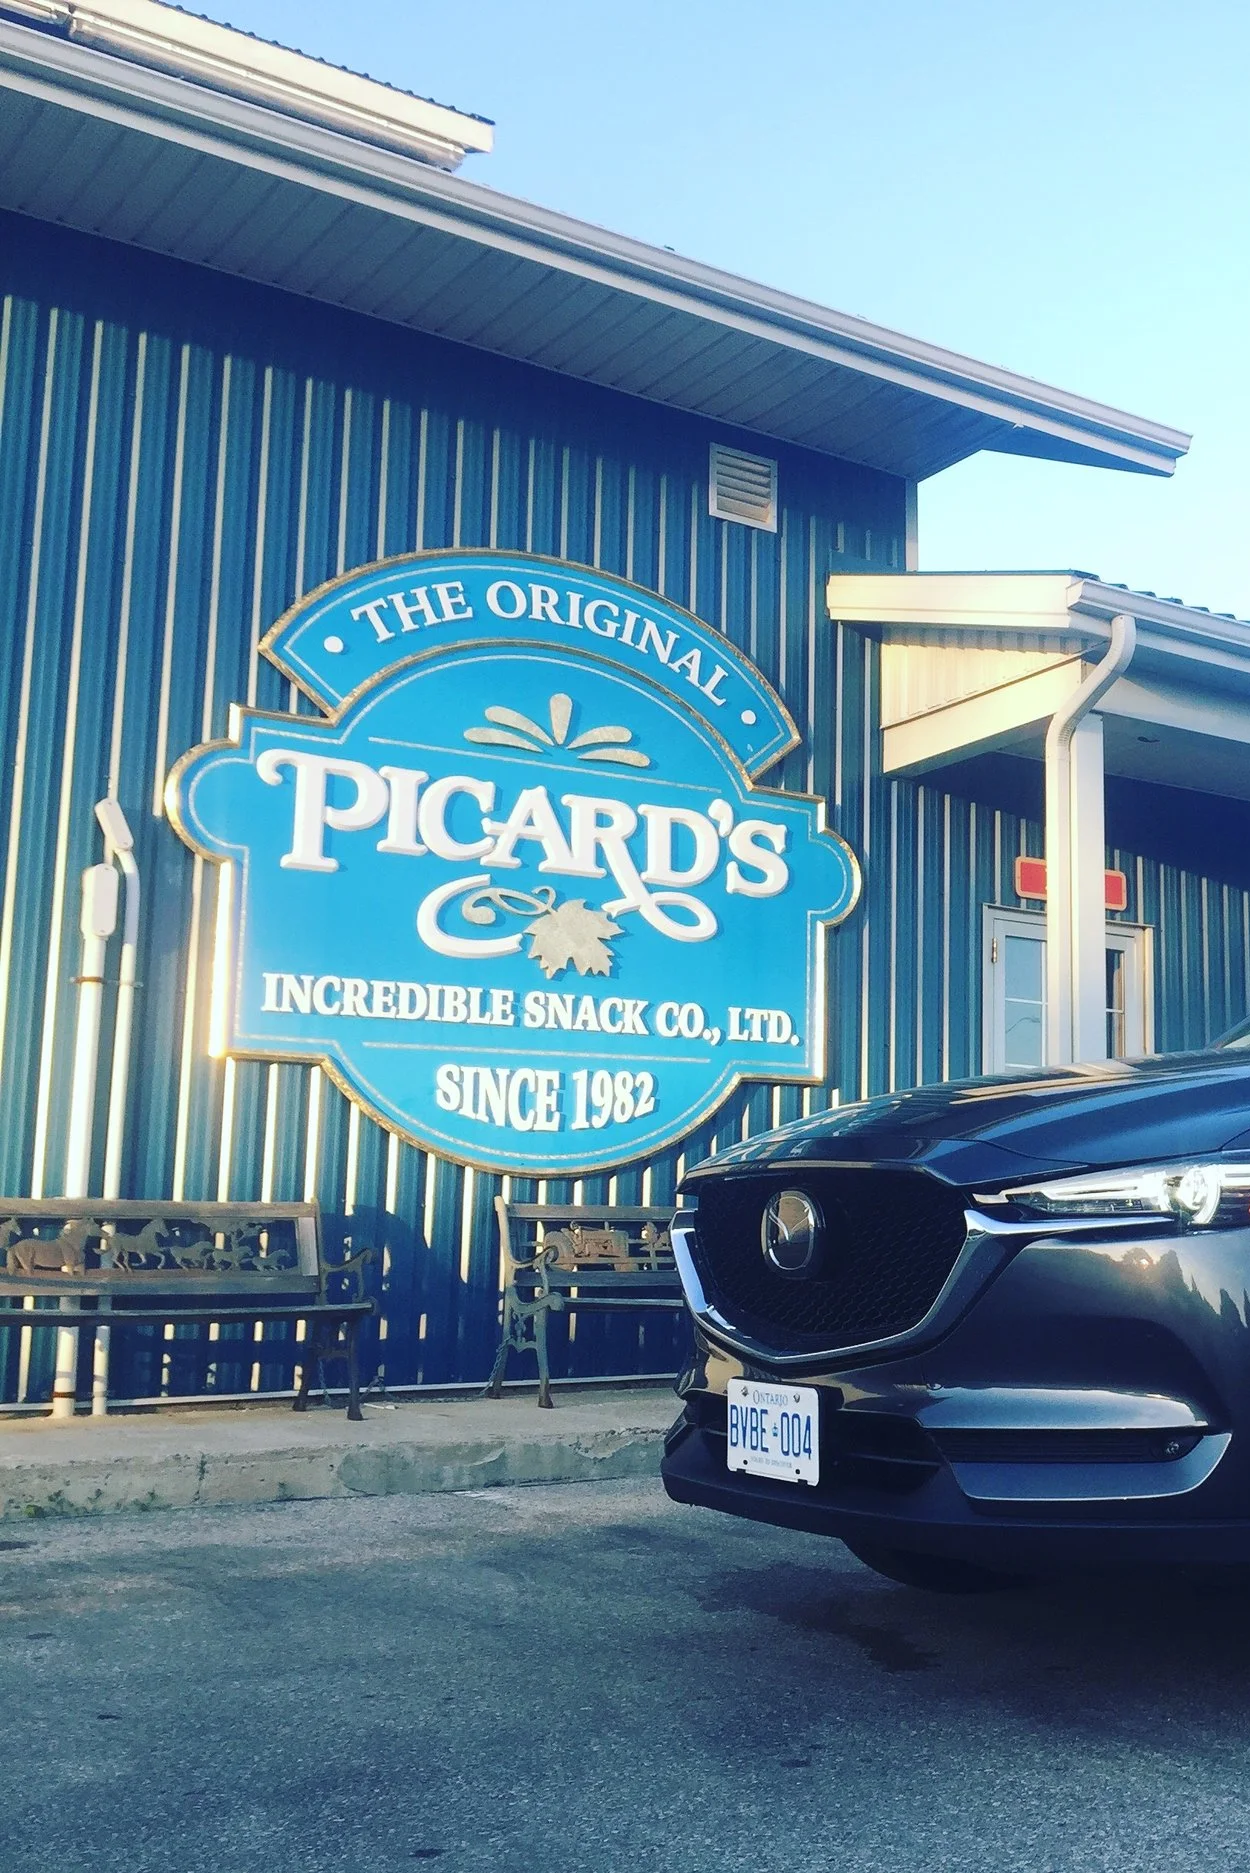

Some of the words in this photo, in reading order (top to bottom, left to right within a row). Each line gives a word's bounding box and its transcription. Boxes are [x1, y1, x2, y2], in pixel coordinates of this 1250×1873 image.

[351, 580, 474, 645] THE
[485, 579, 728, 707] ORIGINAL
[257, 748, 791, 942] PICARD'S
[261, 972, 516, 1026] INCREDIBLE
[524, 990, 649, 1036] SNACK
[656, 1001, 722, 1047] CO.,
[728, 1006, 802, 1047] LTD.
[436, 1064, 561, 1132] SINCE
[571, 1069, 657, 1129] 1982
[780, 1412, 812, 1460] 004
